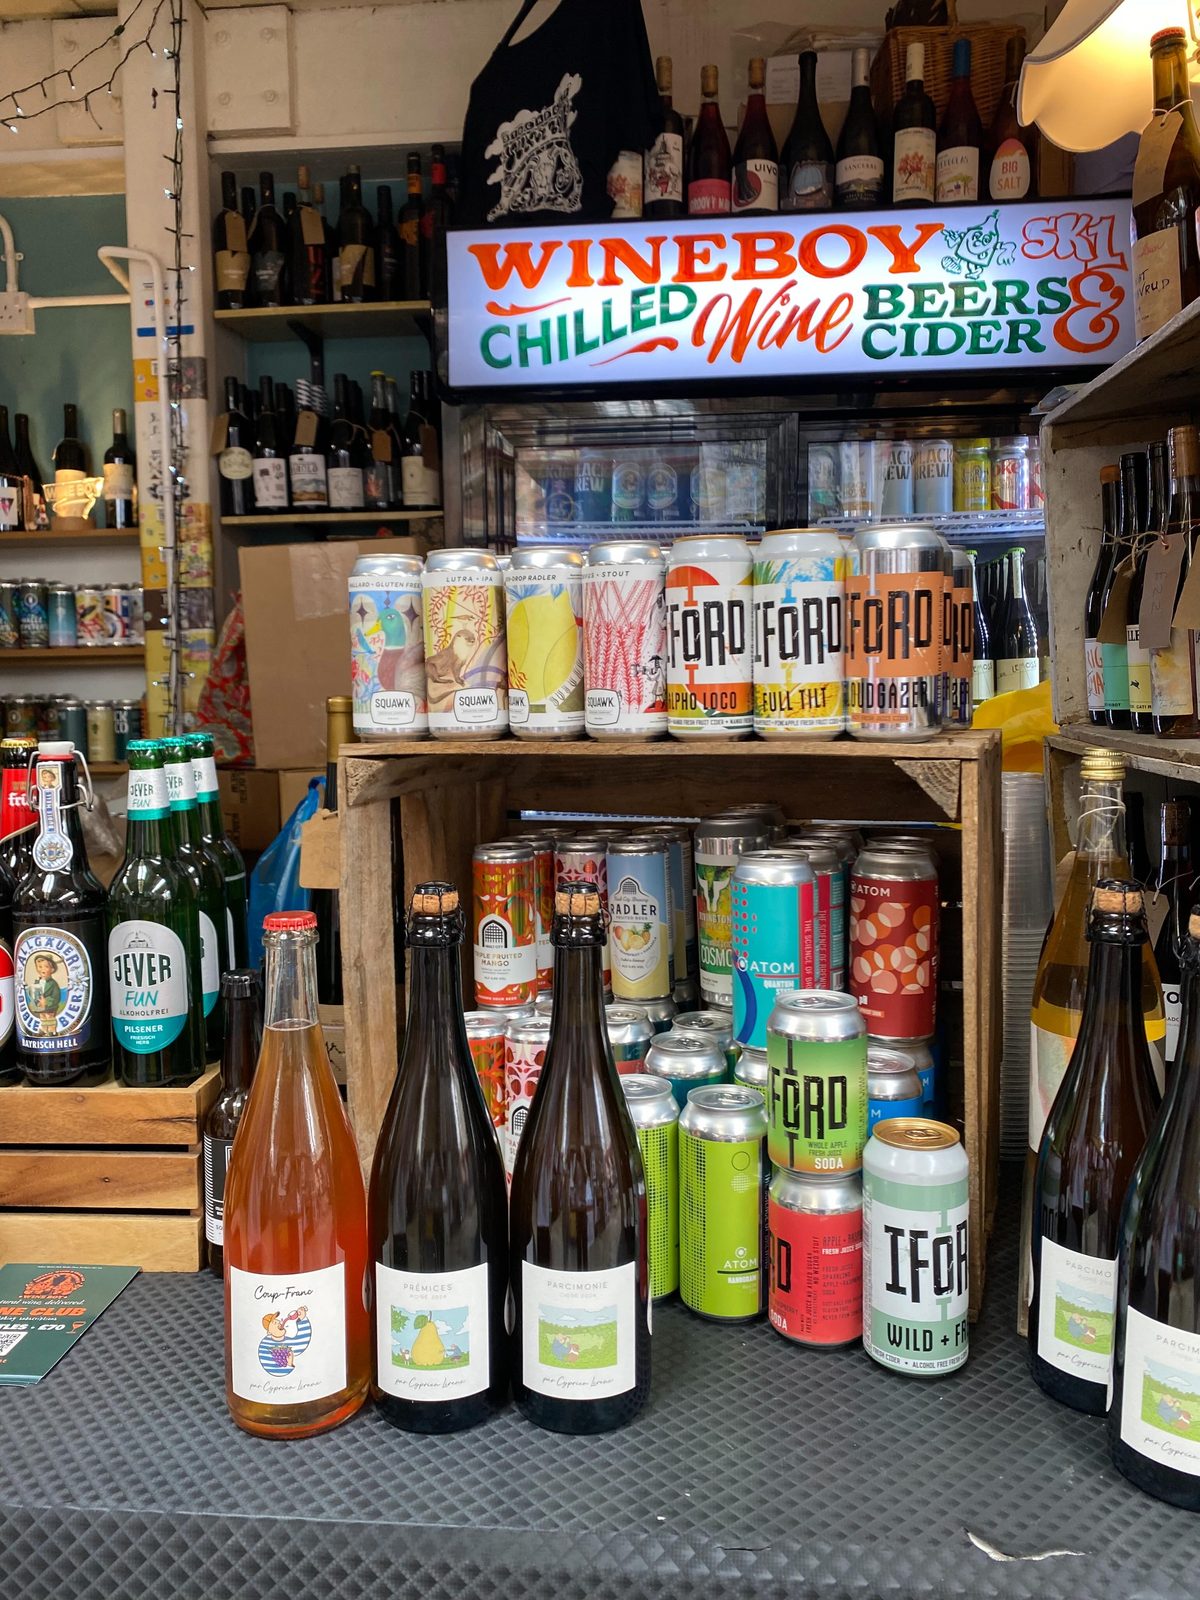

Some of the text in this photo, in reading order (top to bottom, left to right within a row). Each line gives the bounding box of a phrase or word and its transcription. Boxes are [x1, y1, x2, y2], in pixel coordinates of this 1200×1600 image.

[1001, 160, 1018, 175] BIG
[997, 176, 1021, 191] SALT
[467, 223, 945, 290] WINEBOY
[480, 266, 1122, 368] CHILLED Wine BEERS &
[862, 319, 1046, 360] CIDER
[601, 570, 630, 578] STOUT
[844, 590, 933, 660] FORD
[666, 600, 746, 668] FORD
[459, 695, 494, 707] SQUAWK
[703, 691, 737, 710] LOCO
[763, 690, 793, 713] FULL
[847, 681, 928, 709] OUDGAZER
[375, 698, 410, 709] SQUAWK
[587, 696, 614, 708] SQUAWK
[130, 783, 154, 797] JEVER
[132, 798, 151, 808] FUN
[857, 885, 891, 897] ATOM
[610, 903, 657, 916] RADLER
[18, 936, 80, 968] ALLGÄUER
[804, 934, 812, 962] SCIENCE
[492, 952, 523, 960] FRUITED
[113, 953, 172, 988] JEVER
[750, 961, 795, 973] ATOM
[125, 990, 159, 1007] FUN
[59, 994, 83, 1029] BIER
[119, 1008, 169, 1017] ALKOHOLFREI
[124, 1024, 163, 1033] PILSENER
[22, 1038, 78, 1049] BAYRISCH HELL
[767, 1066, 848, 1139] FORD
[807, 1141, 848, 1149] WHOLE APPLE
[814, 1157, 844, 1170] SODA
[723, 1258, 757, 1269] ATOM
[403, 1282, 453, 1292] PRÉMICES
[547, 1281, 608, 1291] PARCIMONIE
[253, 1284, 314, 1304] Coup-Franc
[0, 1307, 87, 1316] NE CLUB
[887, 1319, 969, 1352] WILD + FR
[912, 1361, 936, 1369] ALCOHOL
